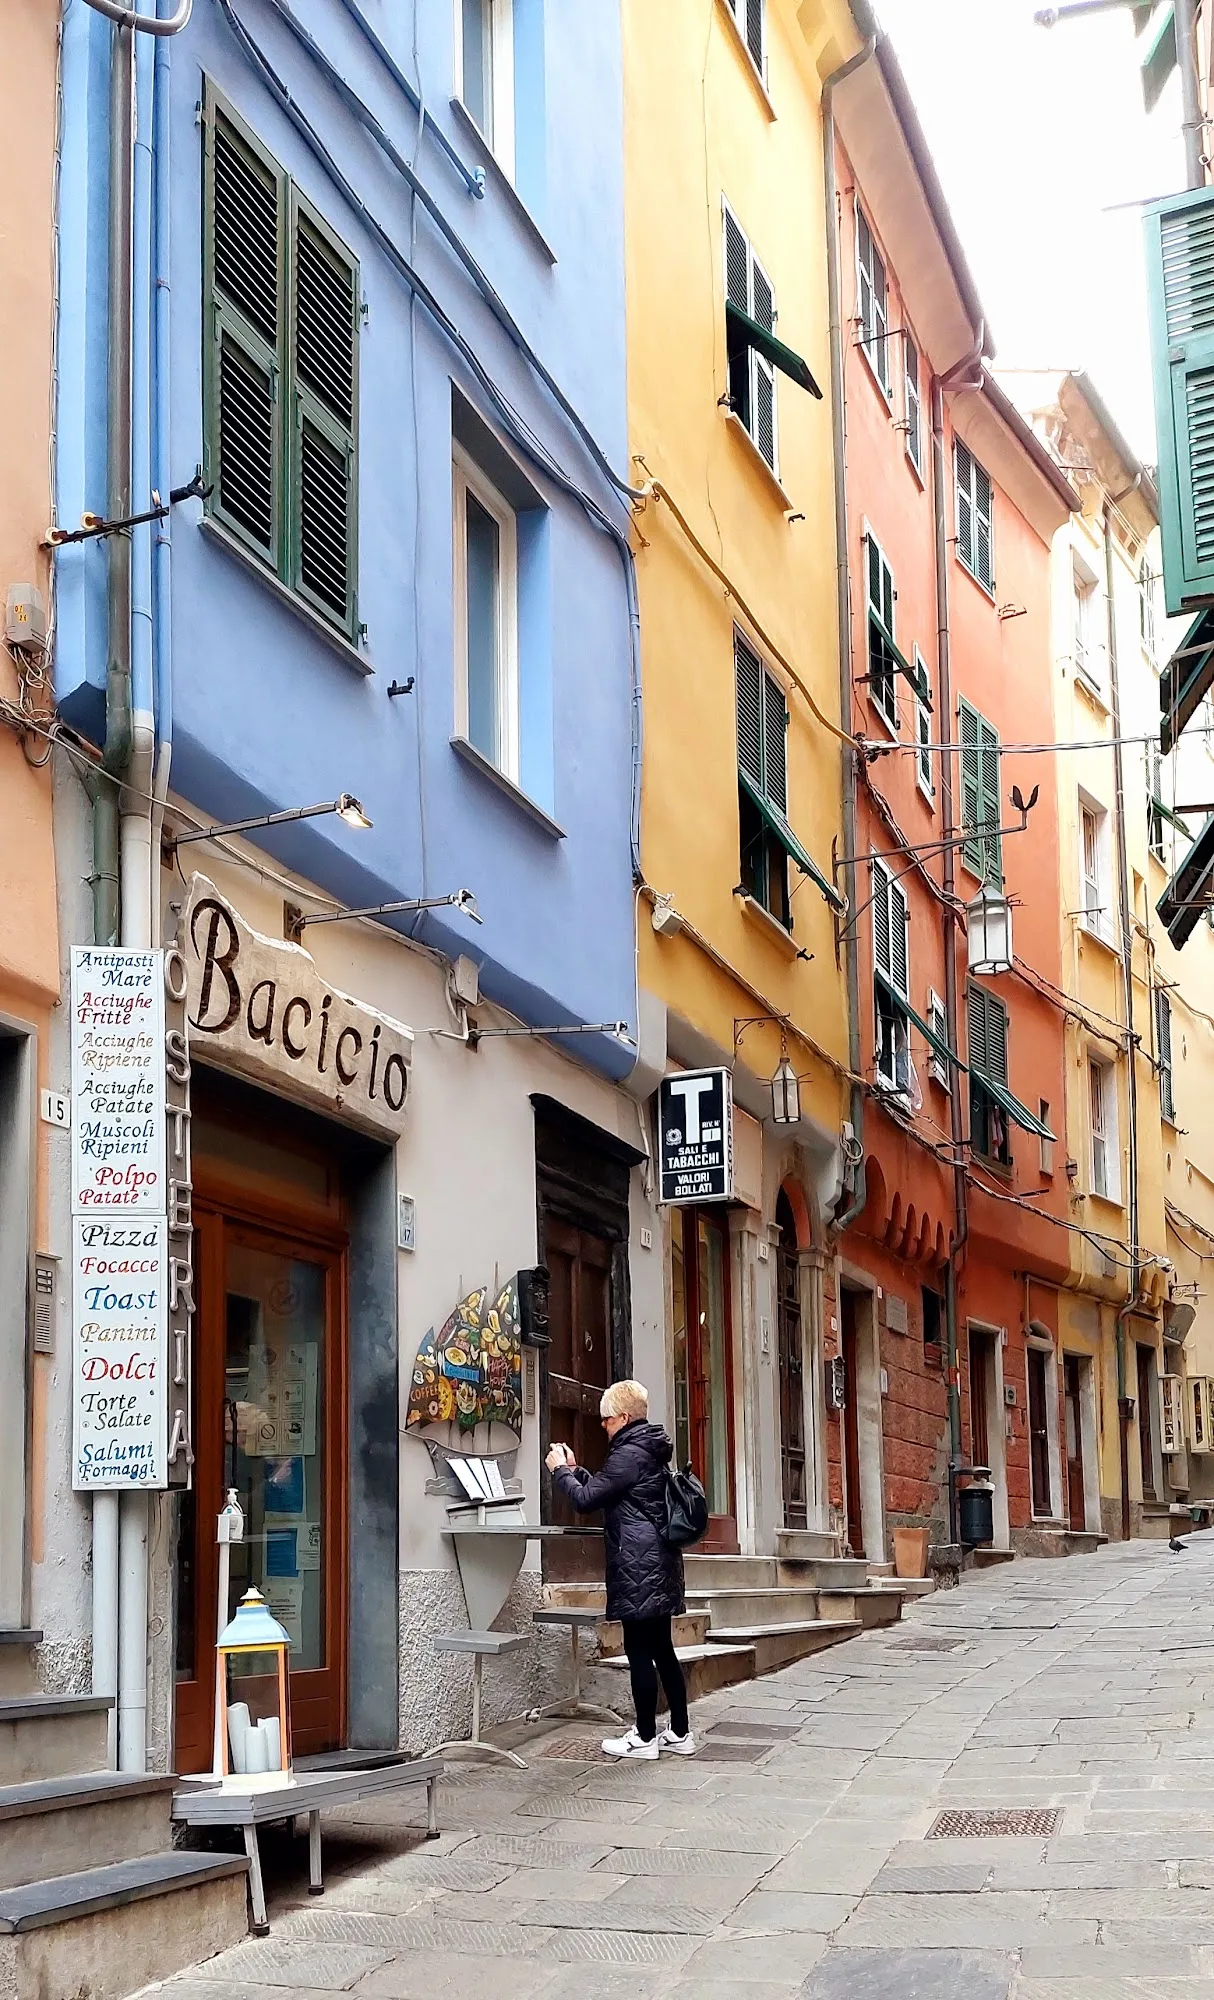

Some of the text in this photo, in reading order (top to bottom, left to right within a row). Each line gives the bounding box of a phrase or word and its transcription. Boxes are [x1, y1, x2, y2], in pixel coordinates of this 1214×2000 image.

[77, 952, 154, 971] Antipasti
[102, 970, 152, 987] Mare
[77, 992, 153, 1014] Acciughe
[188, 898, 408, 1112] Bacicio
[78, 1008, 131, 1025] Fritte
[78, 1032, 154, 1054] Acciughe
[82, 1050, 151, 1072] Ripiene
[78, 1078, 154, 1100] Acciughe
[47, 1096, 64, 1121] 15
[91, 1097, 153, 1114] Patate
[80, 1120, 155, 1138] Muscoli
[81, 1138, 148, 1160] Ripieni
[678, 1145, 707, 1155] SALI E
[667, 1152, 719, 1169] TABACCHI
[95, 1165, 157, 1192] Polpo
[678, 1172, 709, 1184] VALORI
[79, 1189, 138, 1205] Patate
[675, 1183, 712, 1196] BOLLATI
[164, 949, 195, 1466] OSTERIA
[82, 1225, 158, 1247] Pizza
[404, 1229, 411, 1241] 17
[645, 1232, 650, 1243] 19
[80, 1256, 159, 1275] Focacce
[84, 1285, 158, 1310] Toast
[81, 1322, 156, 1343] Panini
[81, 1353, 156, 1381] Dolci
[81, 1392, 137, 1412] Torte
[94, 1411, 152, 1430] Salate
[79, 1441, 154, 1464] Salumi
[79, 1460, 155, 1480] Formaggi
